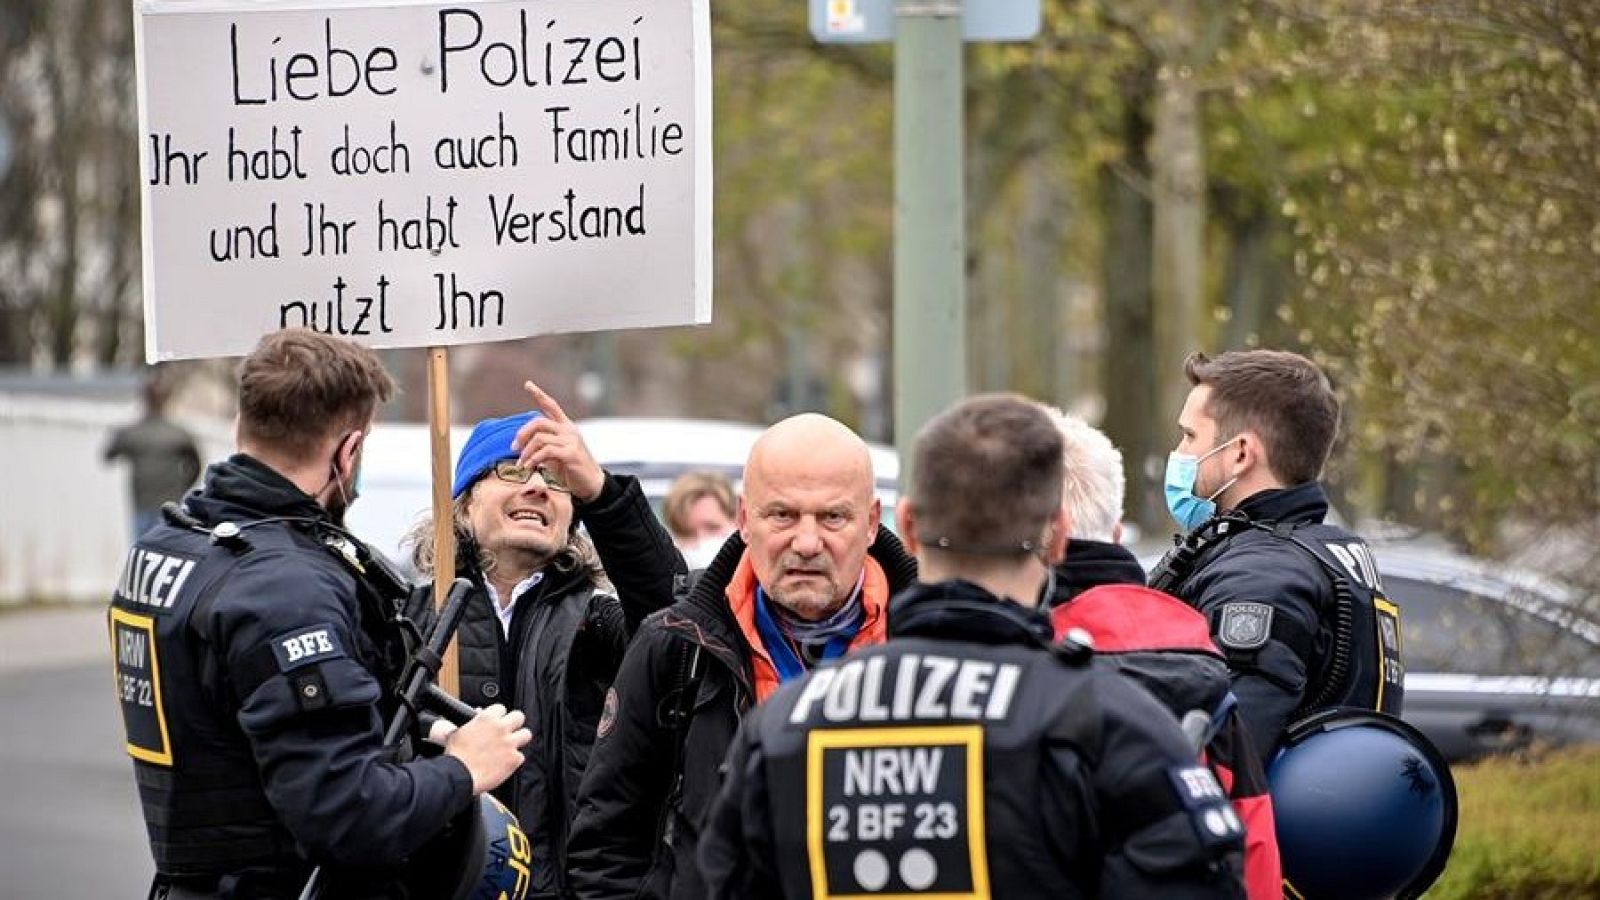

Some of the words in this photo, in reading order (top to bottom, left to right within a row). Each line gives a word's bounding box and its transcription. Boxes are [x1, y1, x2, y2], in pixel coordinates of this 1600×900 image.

[230, 18, 398, 105] Liebe
[438, 8, 644, 94] Polizei
[228, 125, 307, 182] habt
[331, 119, 410, 177] doch
[434, 111, 518, 170] auch
[544, 102, 684, 164] Familie
[210, 202, 279, 262] und
[378, 195, 460, 252] habt
[488, 183, 646, 244] Verstand
[280, 274, 394, 336] nutzt
[281, 630, 334, 662] BFE
[788, 653, 1022, 724] POLIZEI
[843, 748, 943, 797] NRW
[827, 805, 850, 842] 2
[856, 803, 906, 841] BF
[913, 802, 959, 840] 23
